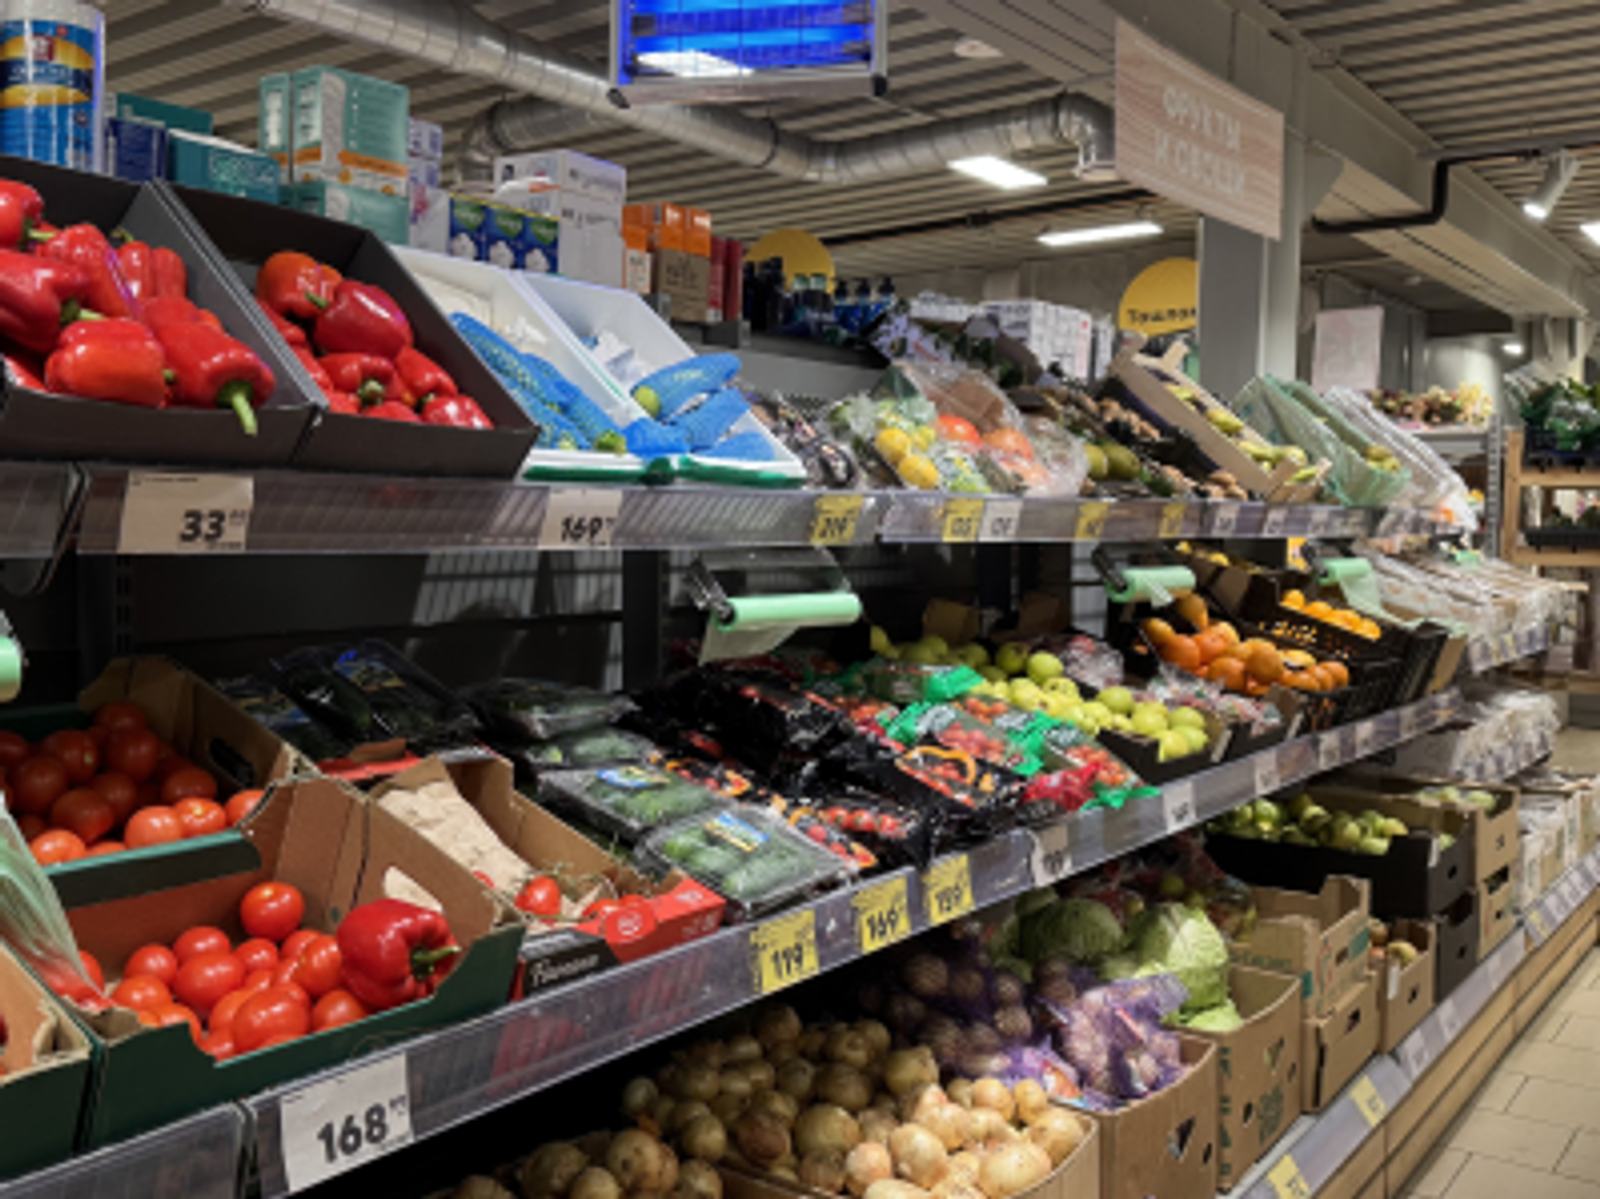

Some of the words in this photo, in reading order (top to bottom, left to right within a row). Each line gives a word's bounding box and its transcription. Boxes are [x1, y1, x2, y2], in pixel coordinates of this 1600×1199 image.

[1162, 84, 1241, 151] ФРУКТЫ
[1155, 129, 1169, 167] И
[1175, 138, 1245, 200] ОВОЩИ
[180, 508, 225, 543] 33
[561, 513, 604, 543] 169
[865, 904, 899, 941] 169
[316, 1102, 388, 1164] 168
